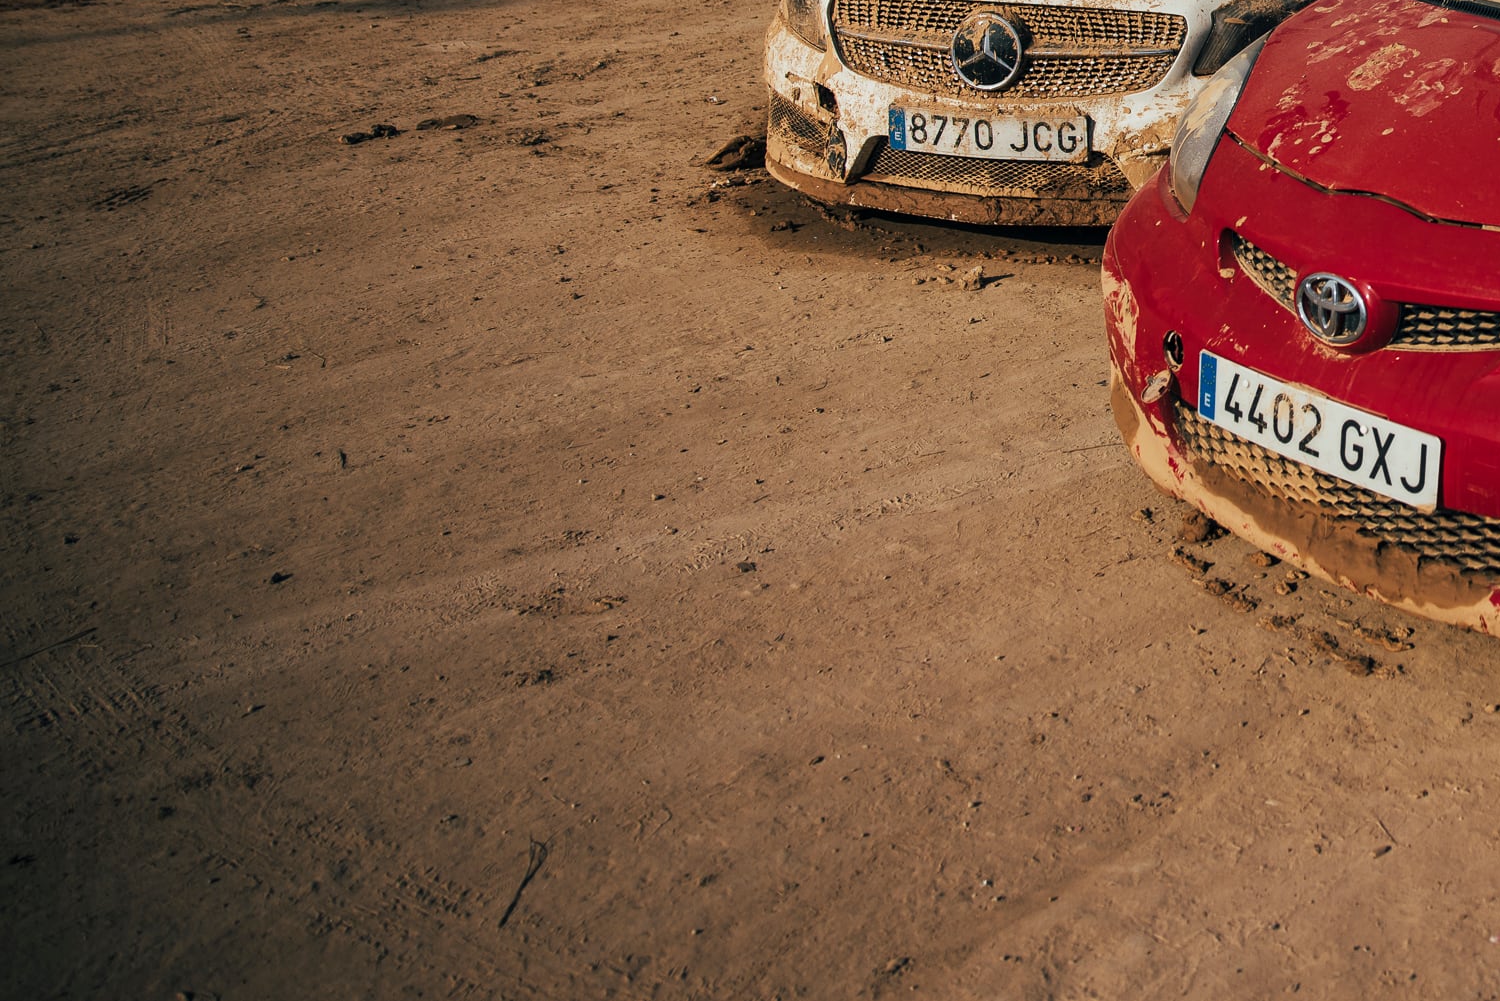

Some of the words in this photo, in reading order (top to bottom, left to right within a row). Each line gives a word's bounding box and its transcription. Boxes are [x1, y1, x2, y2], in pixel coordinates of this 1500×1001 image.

[911, 113, 994, 150] 8770
[1010, 121, 1077, 154] JCG
[1224, 373, 1322, 458] 4402
[1340, 419, 1428, 494] GXJ
